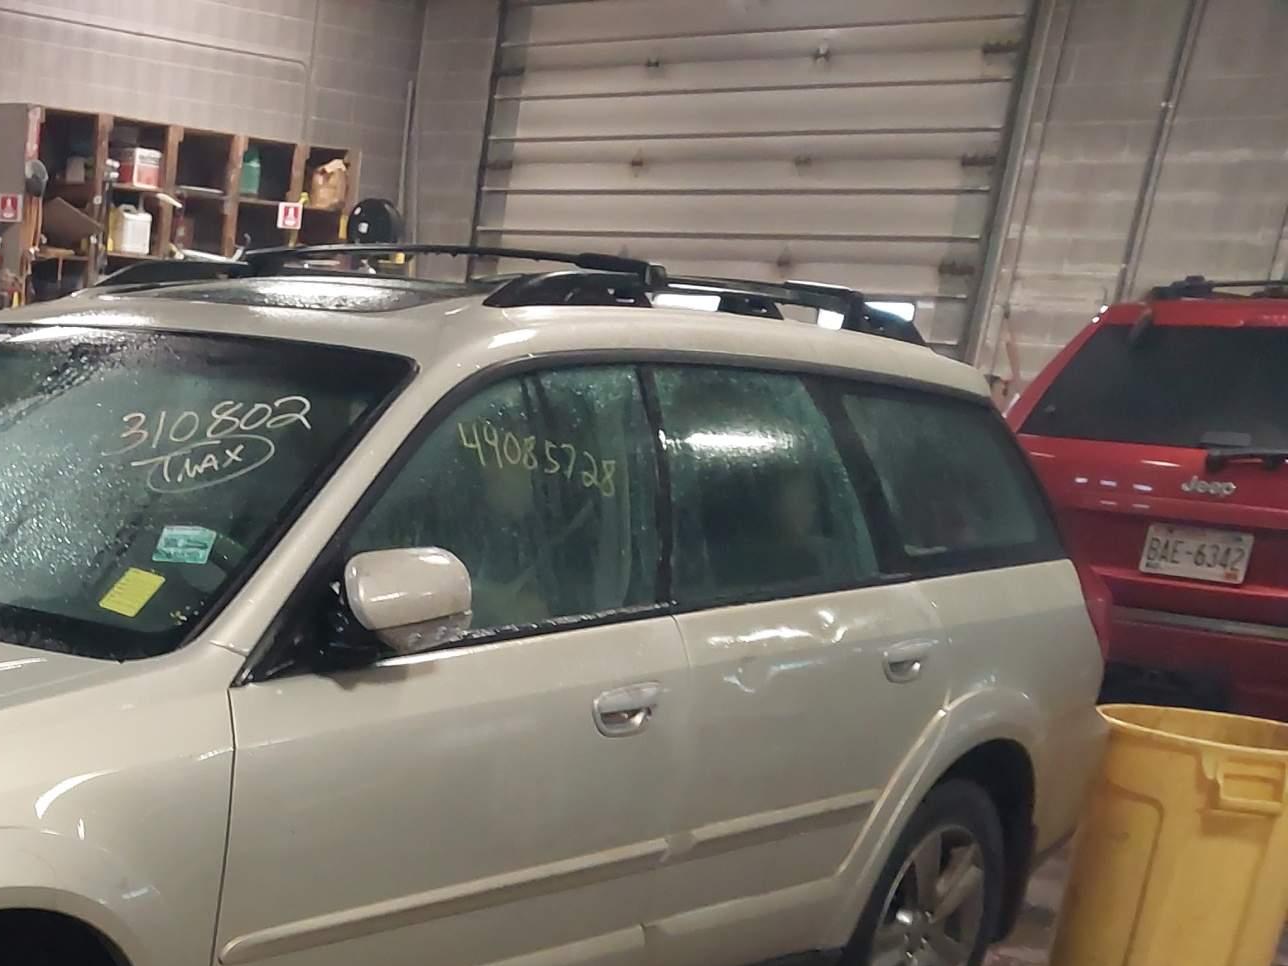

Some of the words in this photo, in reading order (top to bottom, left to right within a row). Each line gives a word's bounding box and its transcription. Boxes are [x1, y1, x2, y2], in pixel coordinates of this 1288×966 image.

[101, 395, 312, 456] 310802
[1180, 474, 1237, 498] Jeep
[1146, 536, 1247, 572] BAE-6342
